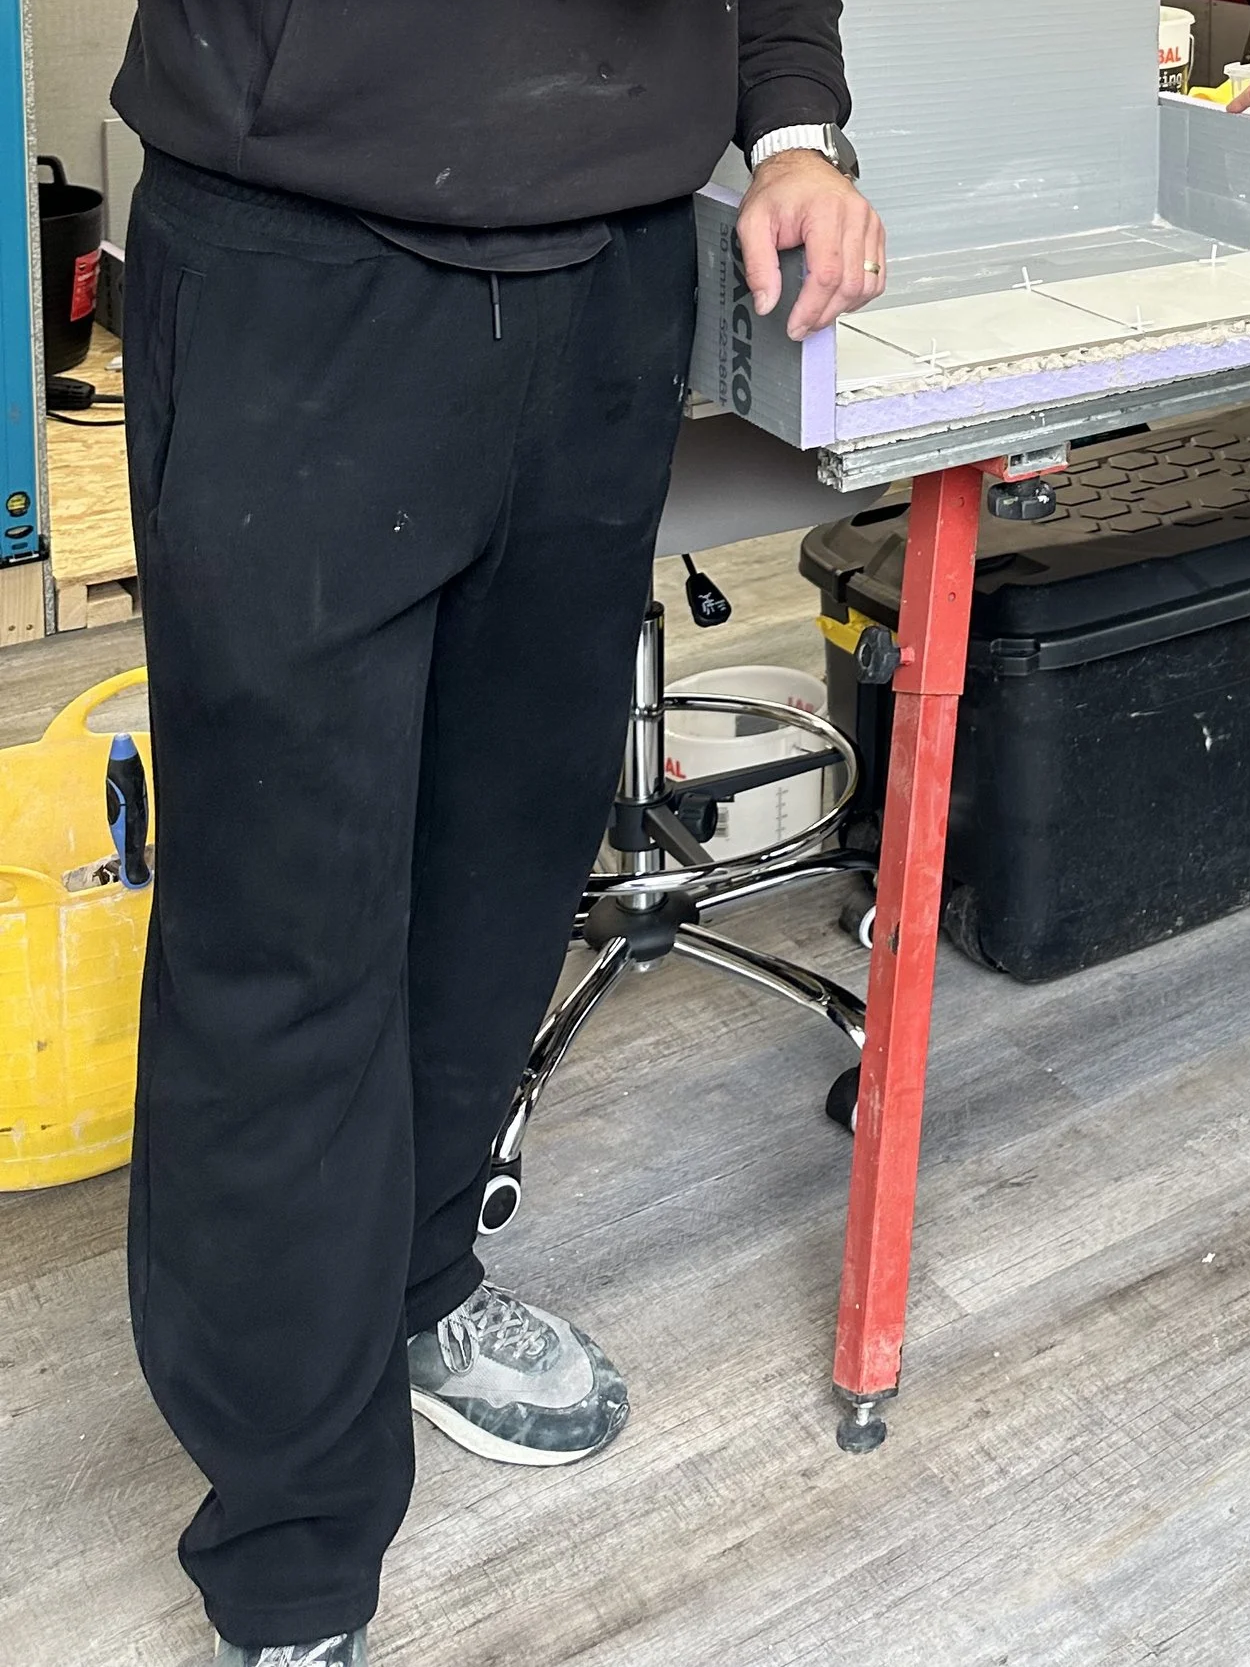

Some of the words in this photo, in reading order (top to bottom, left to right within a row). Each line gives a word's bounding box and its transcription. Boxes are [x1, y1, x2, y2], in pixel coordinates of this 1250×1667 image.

[1159, 71, 1183, 89] ing
[719, 221, 728, 253] 30
[719, 260, 727, 306] mm
